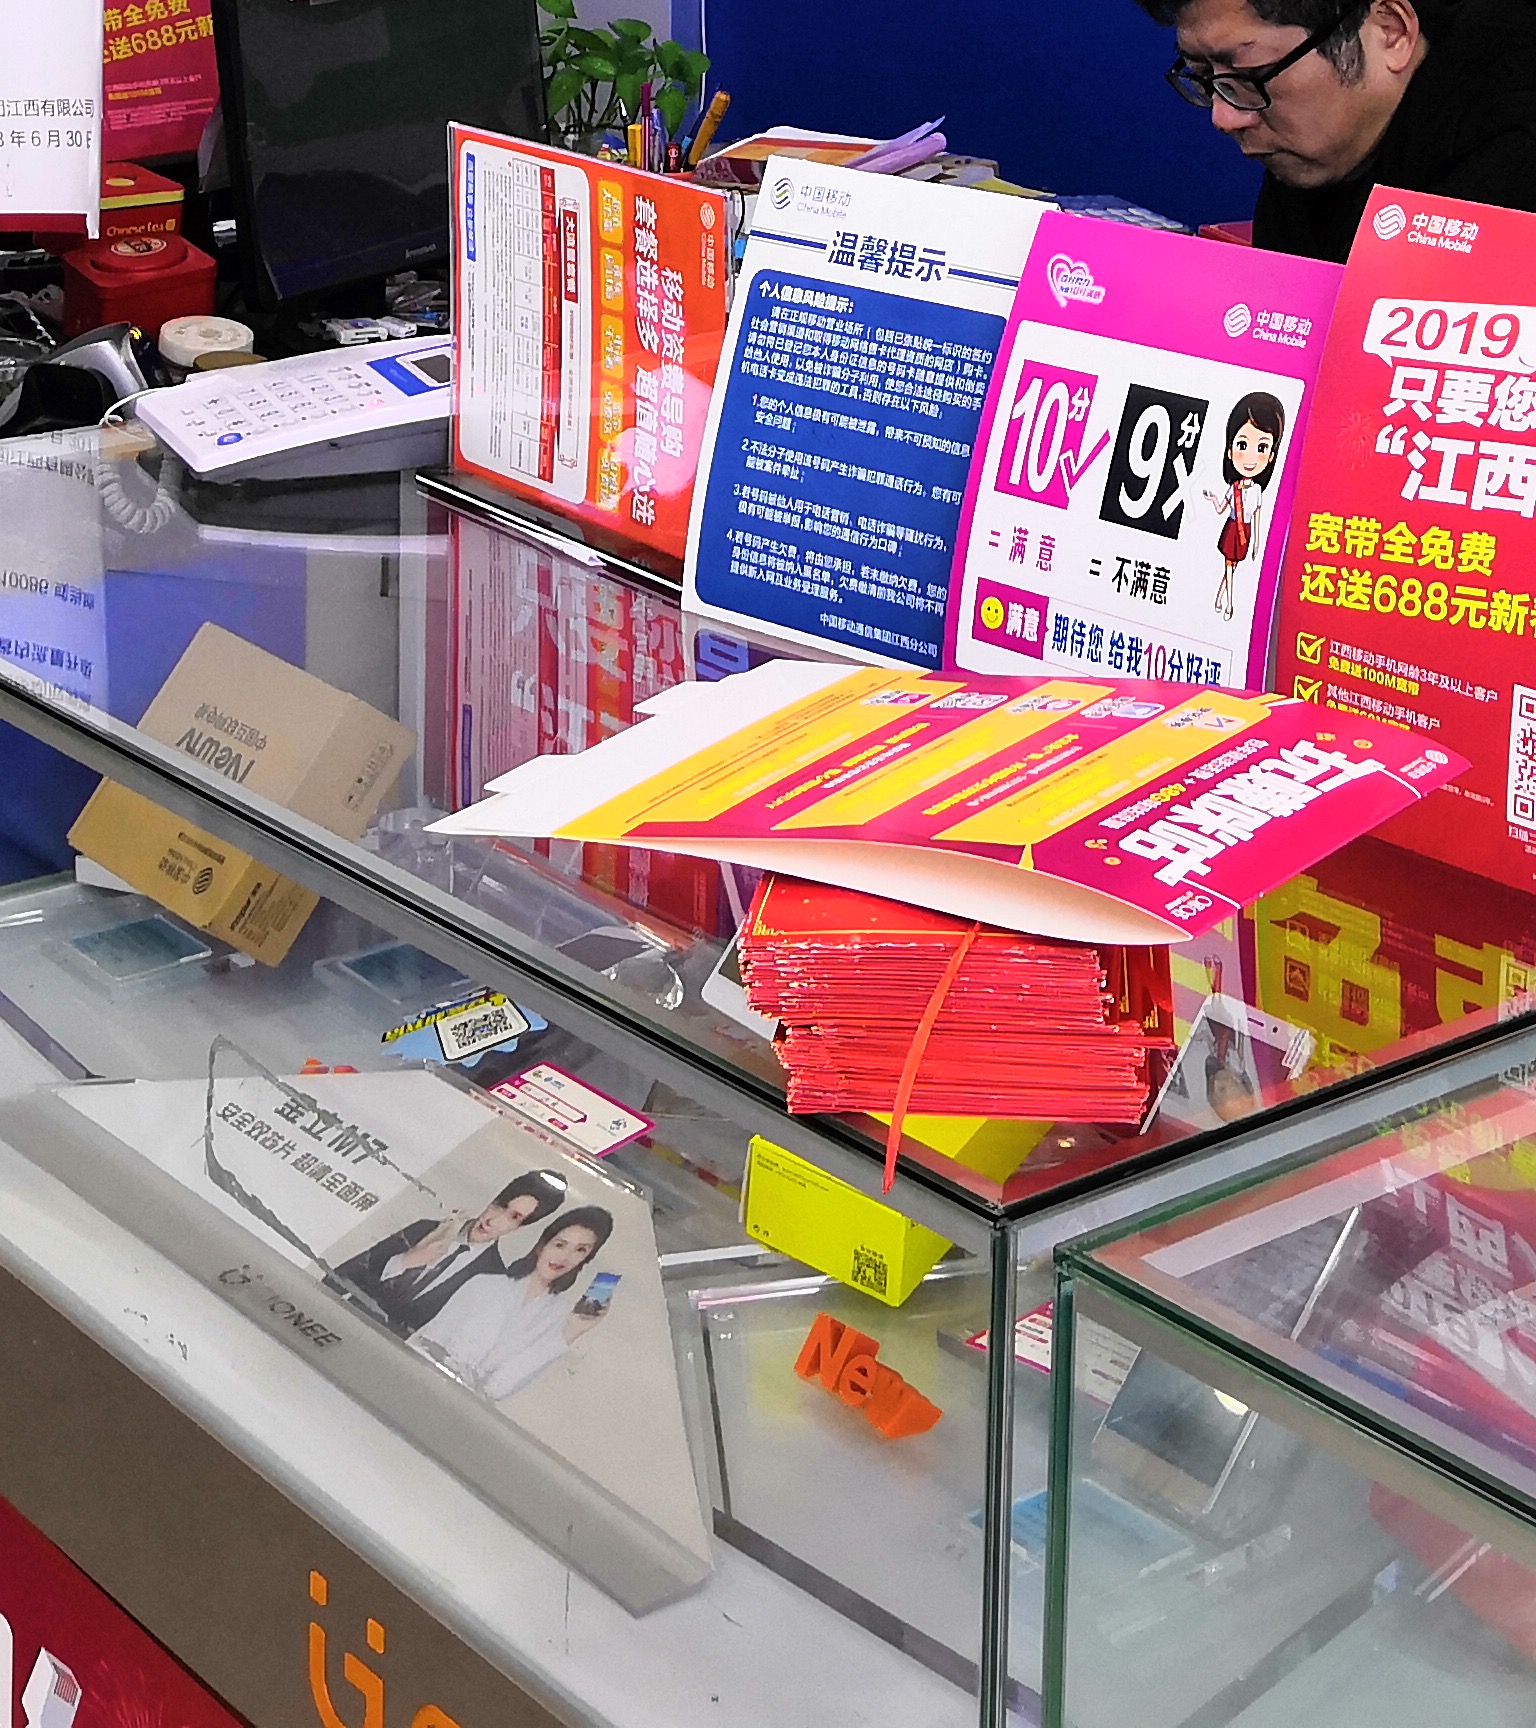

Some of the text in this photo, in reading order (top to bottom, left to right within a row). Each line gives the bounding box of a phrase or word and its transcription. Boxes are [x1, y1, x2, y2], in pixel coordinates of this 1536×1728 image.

[800, 185, 852, 207] 中国移动
[1407, 230, 1472, 254] China Mobile
[1411, 212, 1478, 240] 中国移动
[828, 230, 946, 283] 温馨提示
[1256, 309, 1313, 336] 中国移动
[1380, 306, 1521, 359] 2019
[631, 195, 659, 527] 套餐选择多 超值随心选
[661, 267, 685, 459] 移动资费导购
[1306, 512, 1497, 577] 宽带全免费
[1112, 555, 1172, 605] 不满意
[1005, 601, 1040, 644] 满意
[1052, 613, 1104, 660] 期待您
